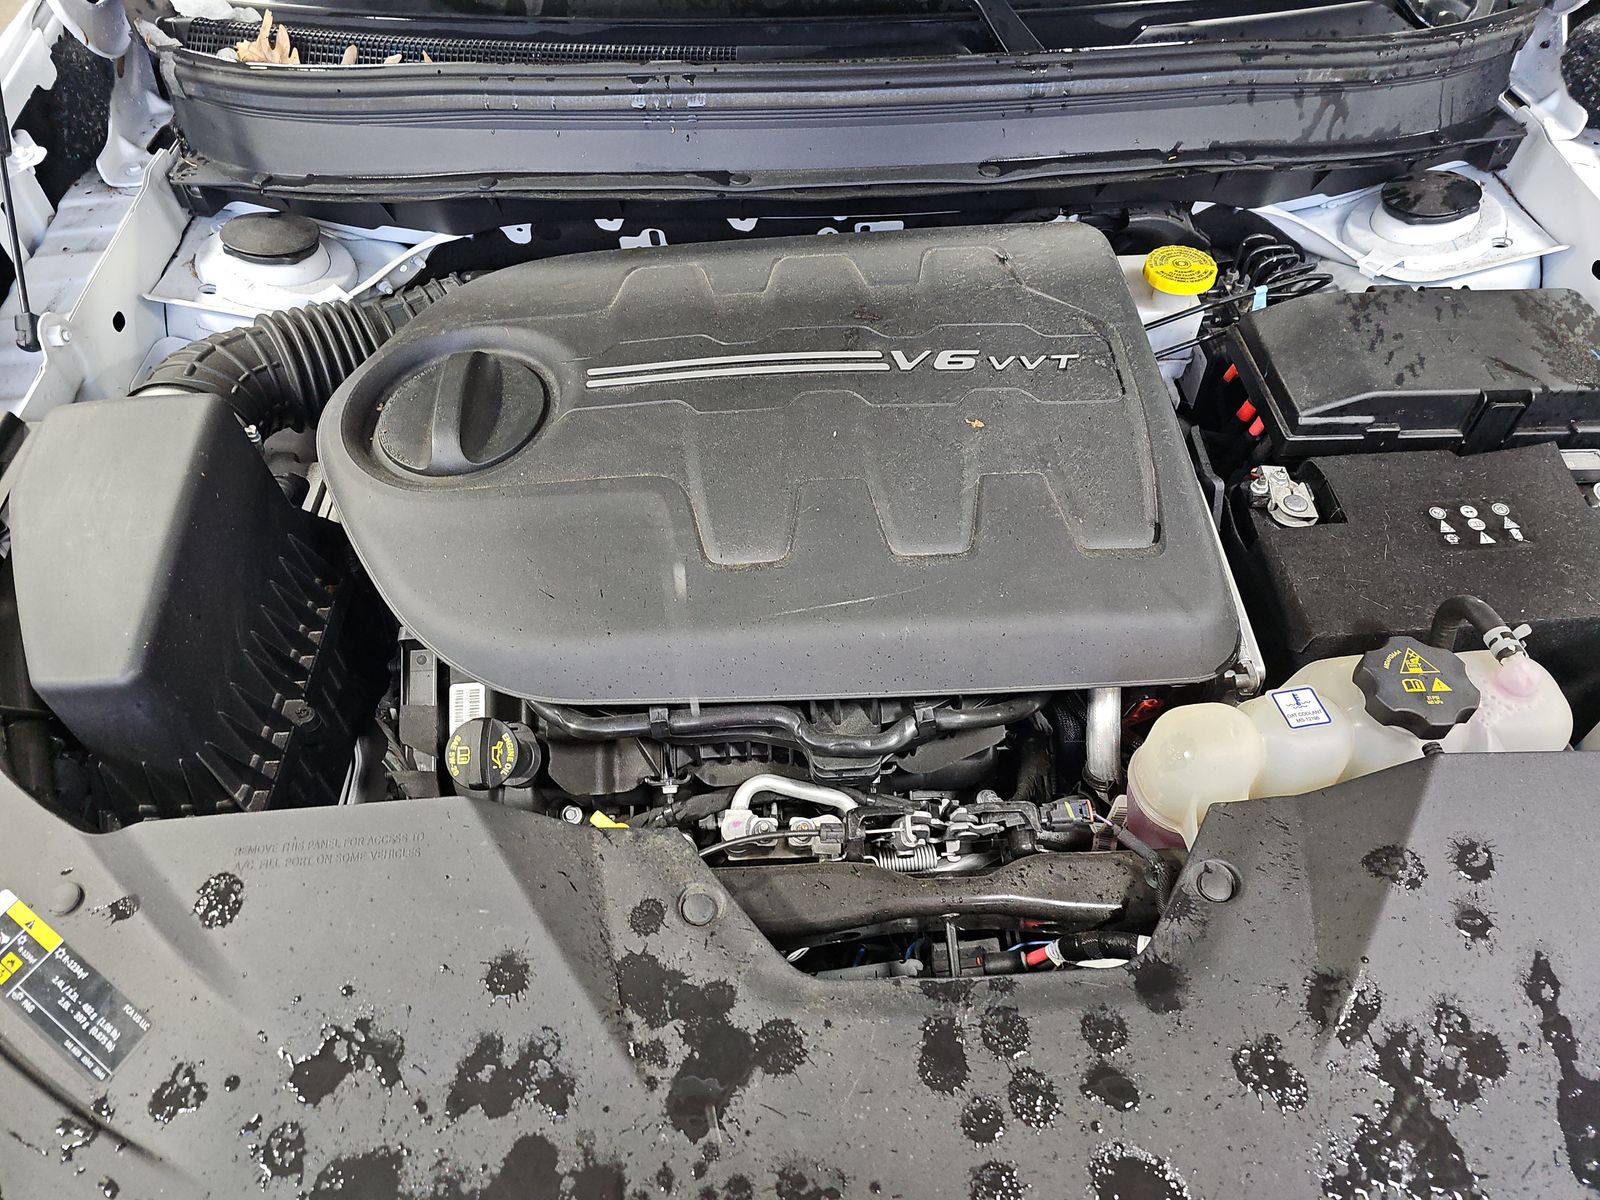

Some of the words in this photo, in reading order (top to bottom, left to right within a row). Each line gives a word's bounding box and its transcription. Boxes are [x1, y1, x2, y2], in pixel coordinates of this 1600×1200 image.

[890, 349, 981, 371] V6
[988, 354, 1080, 370] VVT
[1297, 709, 1322, 717] COOLANT
[450, 735, 462, 750] SAE
[502, 733, 515, 763] ENGINE
[500, 763, 512, 776] OIL
[233, 844, 276, 857] REMOVE
[282, 841, 305, 853] THIS
[307, 838, 339, 851] PANEL
[344, 836, 365, 848] FOR
[366, 832, 408, 846] ACCESS
[412, 831, 425, 842] TO
[260, 857, 281, 870] FILL
[285, 855, 313, 868] PORT
[316, 853, 333, 865] ON
[335, 850, 365, 864] SOME
[370, 846, 422, 861] VEHICLES
[62, 955, 89, 980] R-1234yf
[21, 998, 36, 1014] PAG
[123, 1004, 135, 1018] FCA
[132, 1012, 142, 1024] US
[138, 1019, 151, 1032] LLC
